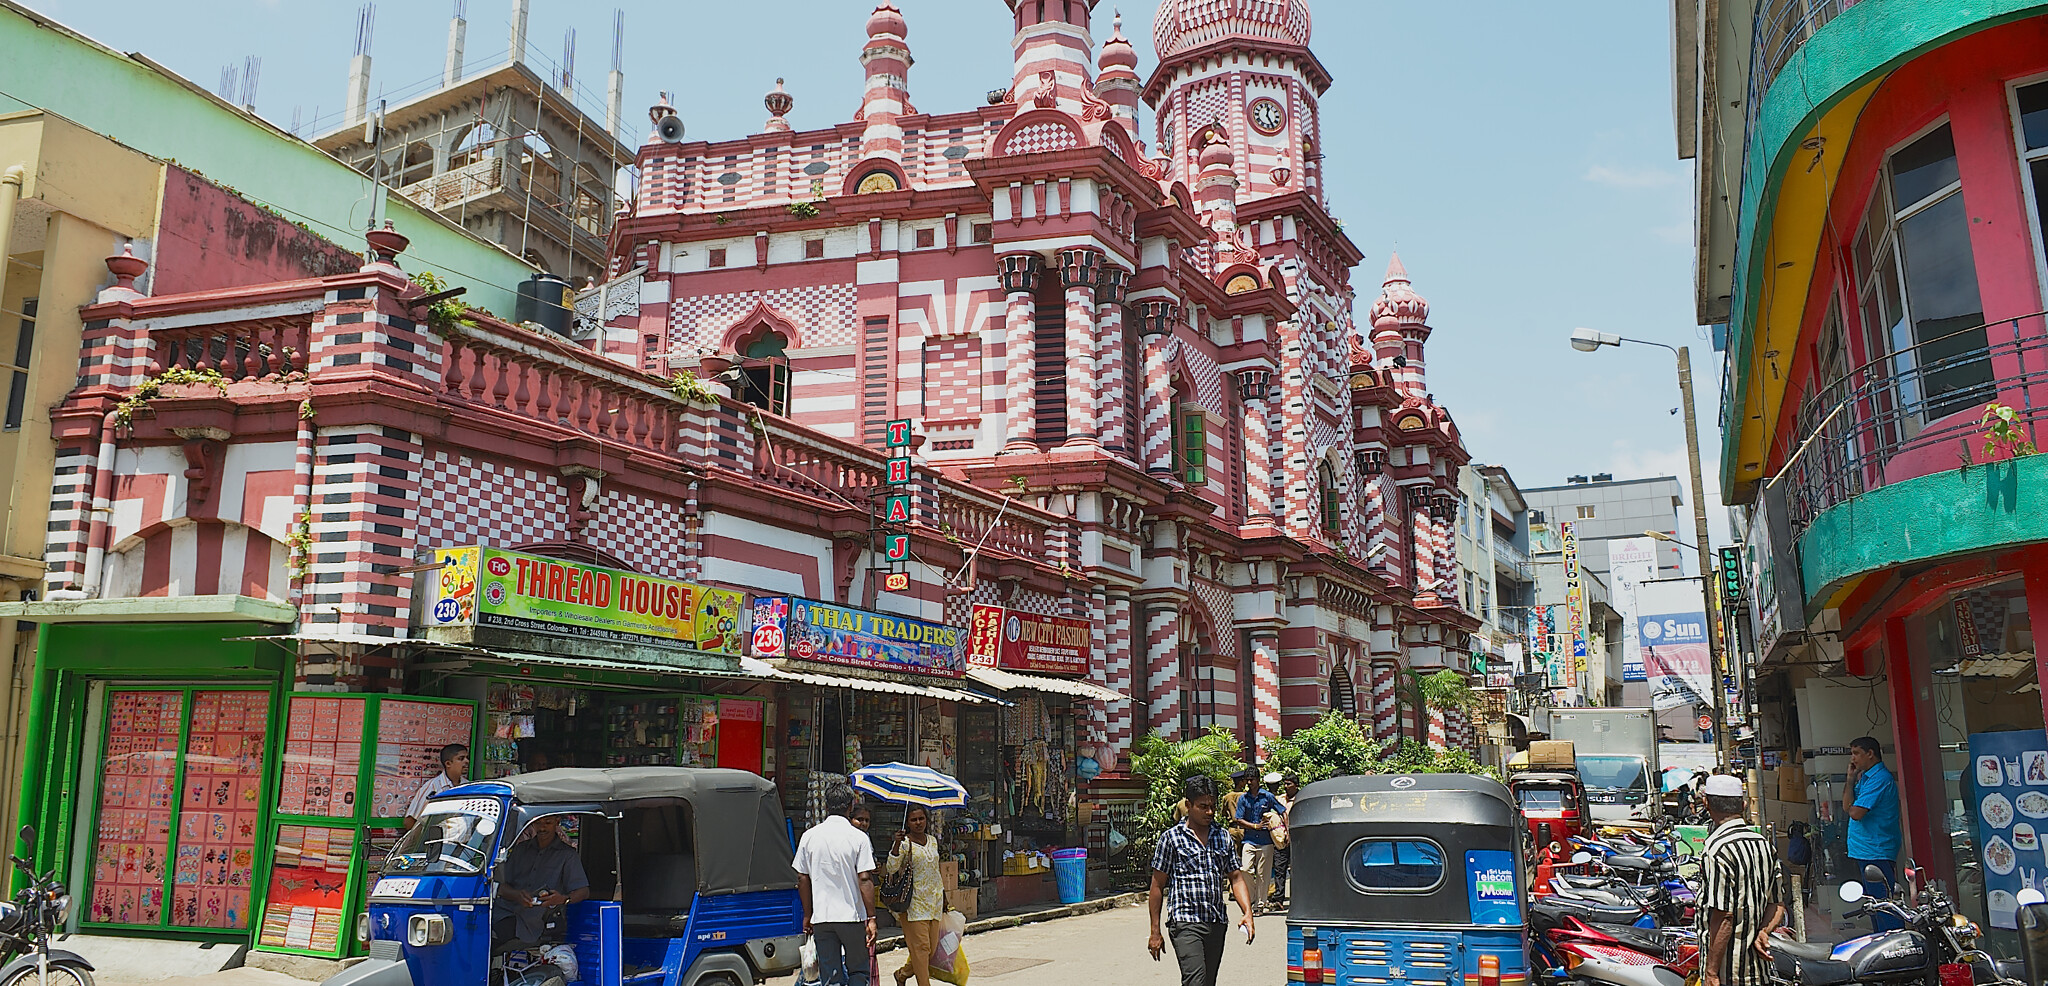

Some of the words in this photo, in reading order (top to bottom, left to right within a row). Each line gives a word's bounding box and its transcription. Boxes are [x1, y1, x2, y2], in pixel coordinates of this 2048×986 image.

[888, 422, 908, 559] THAJ
[1564, 525, 1579, 588] FASHION
[1611, 551, 1652, 561] BRIGHT
[515, 557, 612, 609] THREAD
[618, 575, 693, 622] HOUSE
[889, 576, 904, 587] 236
[436, 602, 457, 618] 238
[529, 606, 557, 617] Importers
[564, 611, 593, 622] Wholesale
[595, 615, 615, 626] Dealers
[622, 620, 647, 630] Garments
[1569, 596, 1583, 640] PLAZA
[504, 617, 513, 626] 2nd
[514, 619, 529, 628] Cross
[546, 622, 568, 632] Colombo
[609, 631, 618, 639] Fax
[809, 605, 863, 632] THAJ
[869, 616, 956, 647] TRADERS
[984, 611, 1000, 657] FASHION
[1020, 619, 1038, 642] NEW
[1037, 622, 1055, 644] CITY
[1055, 625, 1089, 648] FASHION
[1663, 619, 1701, 638] Sun
[756, 629, 781, 649] 236
[973, 618, 986, 655] CITY
[799, 644, 812, 654] 236
[816, 653, 828, 661] 2nd
[828, 656, 850, 664] Cross
[873, 661, 902, 670] Colombo
[972, 655, 992, 664] 234
[1632, 663, 1645, 672] SUPE
[1657, 656, 1700, 670] Astra
[1474, 870, 1513, 882] Telecom
[1555, 866, 1585, 876] POLICE
